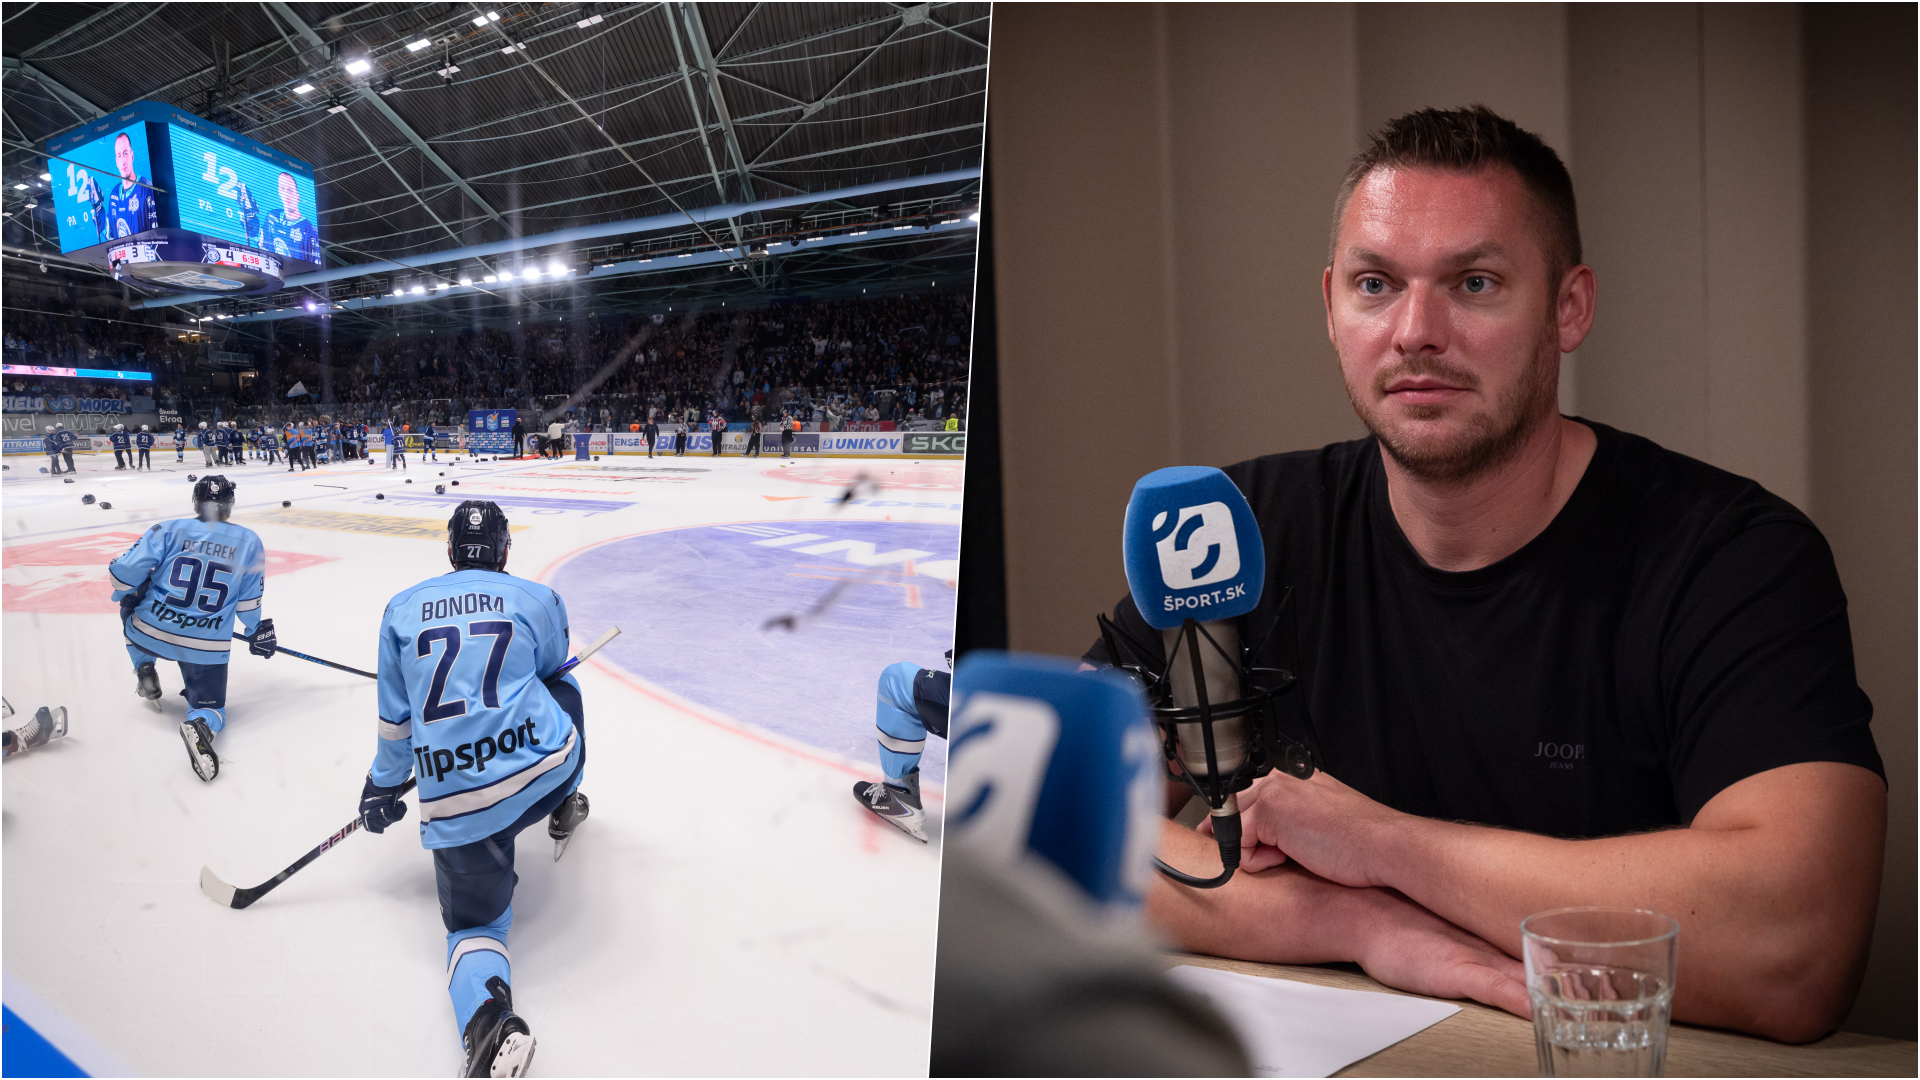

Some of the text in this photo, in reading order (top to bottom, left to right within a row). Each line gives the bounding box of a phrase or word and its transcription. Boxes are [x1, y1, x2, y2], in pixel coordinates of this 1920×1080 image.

[177, 114, 197, 127] Tipsport
[217, 131, 235, 143] Tipsport
[256, 147, 272, 158] Tipsport
[66, 164, 89, 203] 12
[202, 152, 238, 200] 12
[132, 247, 138, 258] 3
[226, 251, 234, 261] 4
[242, 254, 260, 265] 6:38
[265, 259, 271, 269] 3
[56, 413, 119, 431] IMPA
[159, 415, 183, 424] Elroq
[655, 436, 712, 450] BIUS
[835, 438, 900, 450] UNIKOV
[253, 514, 449, 538] PROSTRIEDK
[181, 539, 237, 561] PETEREK
[467, 545, 482, 559] 27
[163, 555, 234, 613] 95
[1163, 582, 1246, 611] ŠPORT.SK
[151, 599, 224, 630] Tipsport
[421, 592, 505, 623] BONDRA
[416, 619, 514, 726] 27
[413, 716, 541, 783] Tipsport
[1533, 741, 1585, 760] JOOP!
[1549, 761, 1574, 770] JEANS
